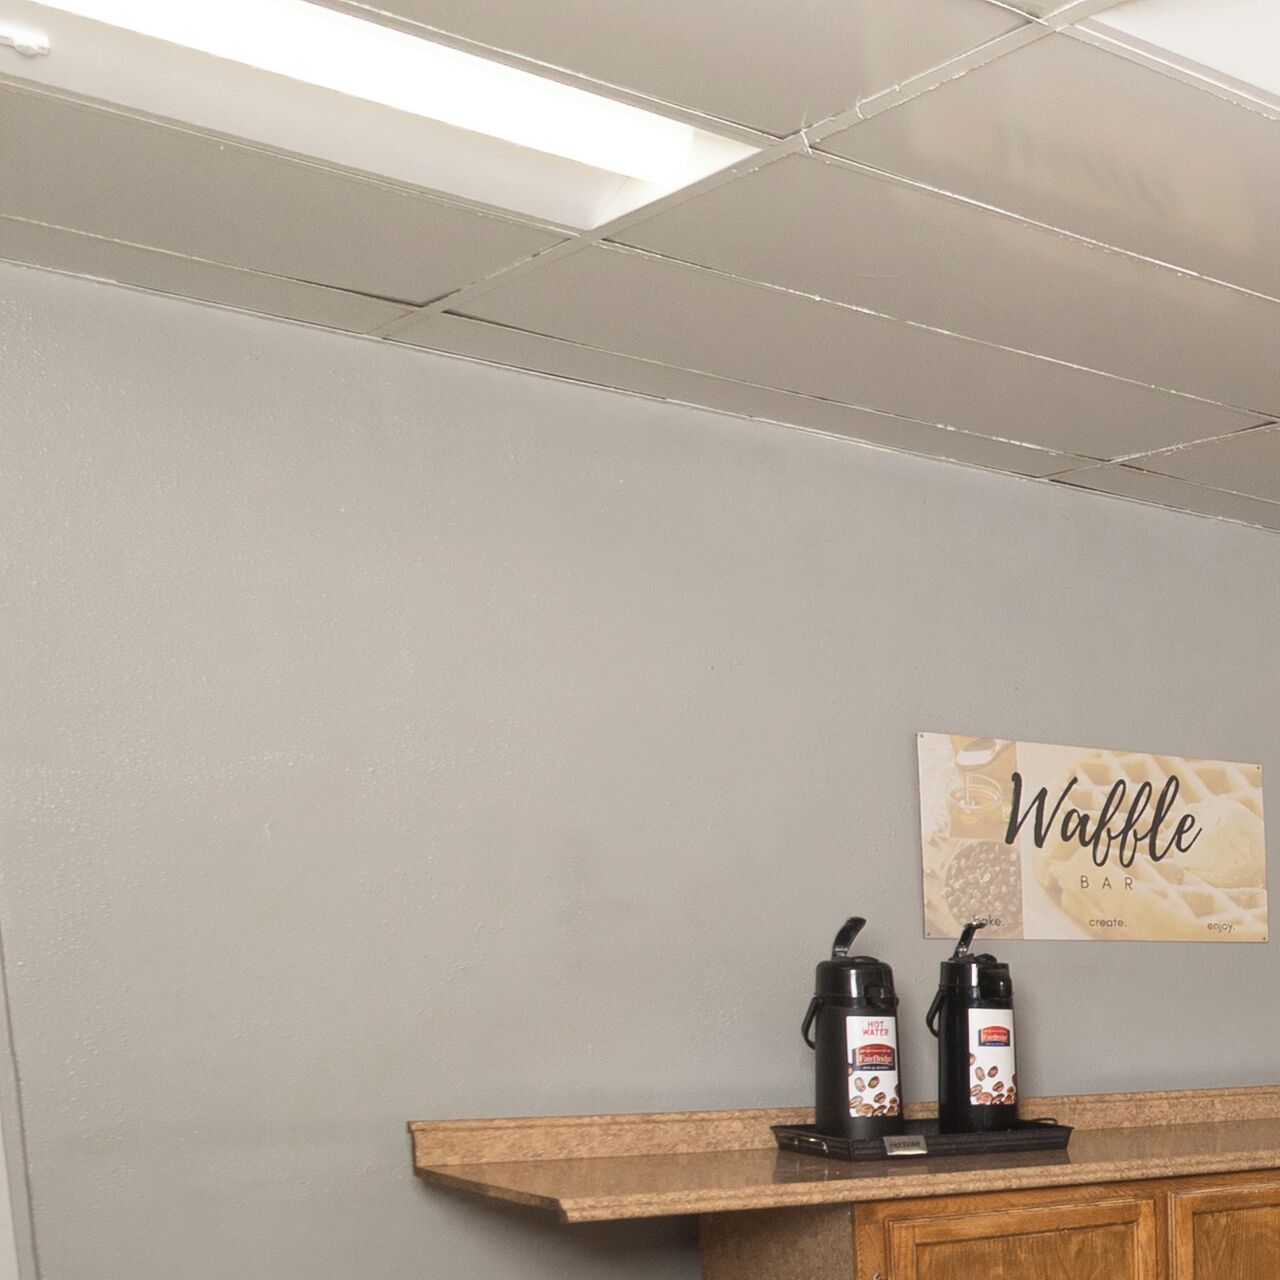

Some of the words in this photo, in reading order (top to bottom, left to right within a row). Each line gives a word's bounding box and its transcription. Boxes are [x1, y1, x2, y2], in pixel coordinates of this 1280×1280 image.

[1005, 771, 1203, 868] Waffle
[1088, 916, 1128, 928] create.
[1207, 921, 1236, 933] enjoy.
[867, 1021, 885, 1029] HOT
[862, 1028, 889, 1036] WATER
